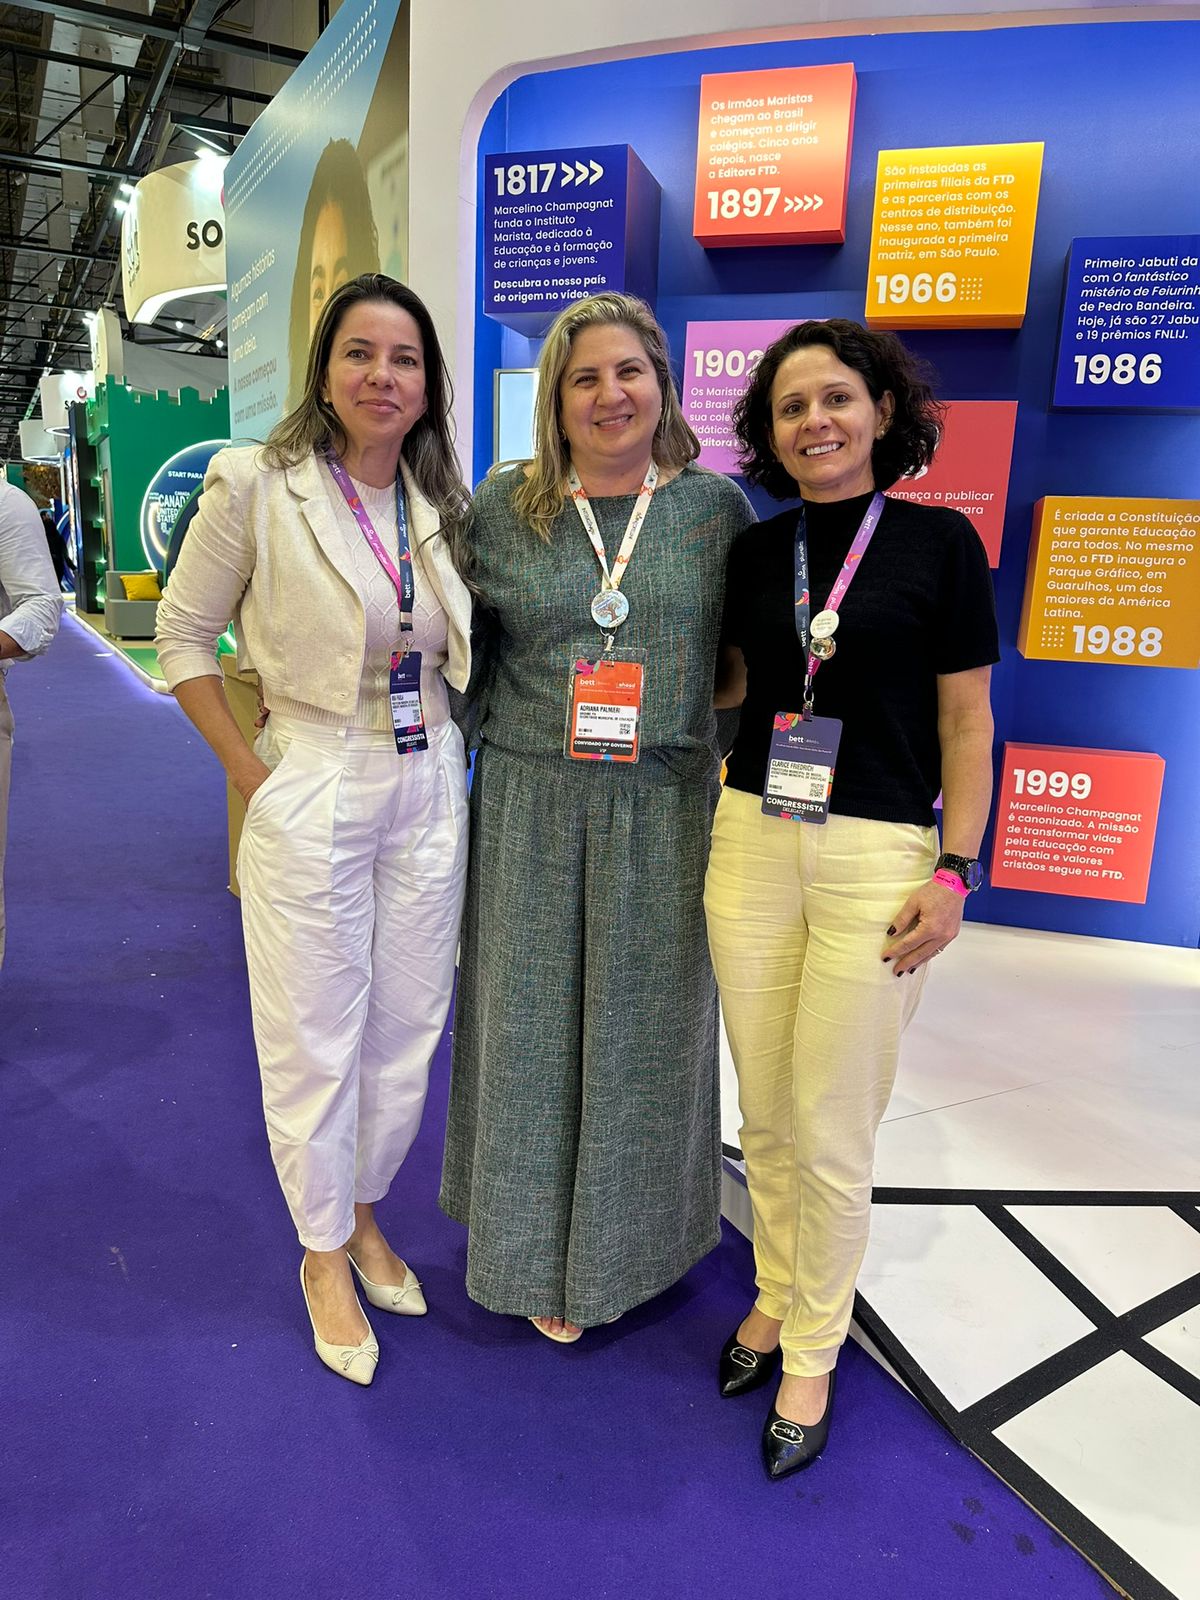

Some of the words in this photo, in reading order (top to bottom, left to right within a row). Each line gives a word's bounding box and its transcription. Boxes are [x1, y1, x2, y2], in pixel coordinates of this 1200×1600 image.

[494, 163, 556, 196] 1817
[709, 171, 716, 179] a
[719, 168, 756, 178] Editora
[758, 165, 780, 176] FTD.
[882, 179, 938, 193] primeiras
[941, 176, 972, 187] filiais
[974, 176, 991, 186] da
[993, 174, 1015, 186] FTD
[708, 187, 781, 219] 1897
[882, 196, 890, 205] e
[891, 196, 906, 204] as
[908, 192, 963, 206] parcerias
[966, 192, 993, 201] com
[995, 190, 1009, 199] os
[494, 203, 543, 215] Marcelino
[545, 199, 614, 213] Champagnat
[881, 209, 924, 219] centros
[926, 207, 941, 217] de
[944, 204, 1016, 217] distribuição.
[494, 218, 523, 229] funda
[525, 219, 532, 227] o
[534, 215, 576, 226] Instituto
[880, 224, 914, 233] Nesse
[916, 223, 941, 231] ano,
[944, 219, 995, 230] também
[997, 217, 1012, 228] foi
[494, 232, 533, 242] Marista,
[535, 228, 584, 240] dedicado
[586, 227, 593, 237] à
[879, 235, 945, 249] inaugurada
[948, 236, 956, 244] a
[959, 232, 1009, 246] primeira
[494, 244, 543, 257] Educação
[545, 245, 552, 253] e
[554, 242, 561, 252] à
[563, 240, 613, 253] formação
[878, 250, 916, 261] matriz,
[918, 251, 937, 259] em
[940, 248, 962, 258] São
[965, 247, 1000, 257] Paulo.
[494, 259, 507, 269] de
[509, 258, 552, 270] crianças
[554, 258, 561, 266] e
[562, 256, 598, 268] jovens.
[1085, 258, 1136, 269] Primeiro
[1138, 256, 1179, 268] Jabuti
[1181, 256, 1198, 266] da
[494, 278, 542, 289] Descubra
[543, 279, 550, 287] o
[552, 278, 582, 286] nosso
[584, 274, 606, 288] país
[1083, 275, 1110, 283] com
[1113, 273, 1123, 283] O
[1125, 271, 1189, 282] fantástico
[876, 272, 957, 304] 1966
[1081, 286, 1131, 297] mistério
[1133, 286, 1150, 296] de
[494, 293, 507, 302] de
[508, 291, 544, 304] origem
[546, 292, 559, 300] no
[560, 289, 592, 300] vídeo.
[1079, 302, 1095, 312] de
[1098, 301, 1133, 311] Pedro
[1136, 300, 1195, 311] Bandeira.
[1078, 316, 1107, 329] Hoje,
[1109, 315, 1122, 329] já
[1125, 316, 1148, 325] são
[1151, 315, 1165, 325] 27
[1076, 332, 1084, 340] e
[1087, 330, 1099, 340] 19
[1101, 329, 1152, 343] prêmios
[1155, 330, 1188, 339] FNLIJ.
[1074, 354, 1162, 385] 1986
[691, 387, 704, 396] Os
[690, 400, 703, 409] do
[158, 496, 188, 508] CANAD
[884, 490, 931, 503] começa
[934, 492, 942, 500] a
[945, 491, 995, 503] publicar
[864, 514, 874, 530] bett
[1055, 509, 1061, 521] É
[1064, 511, 1105, 522] criada
[1108, 514, 1116, 522] a
[1120, 512, 1200, 526] Constituição
[1053, 527, 1077, 537] que
[1080, 527, 1130, 538] garante
[1133, 527, 1197, 540] Educação
[1051, 541, 1081, 551] para
[1084, 540, 1122, 550] todos.
[1125, 541, 1143, 551] No
[1146, 543, 1194, 552] mesmo
[1050, 554, 1076, 565] ano,
[1080, 555, 1088, 563] a
[1091, 554, 1114, 564] FTD
[1117, 554, 1175, 568] inaugura
[1178, 558, 1187, 566] o
[1049, 567, 1092, 579] Parque
[1095, 568, 1143, 580] Gráfico,
[1146, 571, 1167, 579] em
[1047, 581, 1113, 593] Guarulhos,
[1116, 584, 1136, 593] um
[1140, 583, 1163, 594] dos
[1046, 594, 1095, 605] maiores
[1098, 596, 1115, 606] da
[1118, 597, 1171, 608] América
[1044, 608, 1084, 618] Latina.
[1073, 625, 1163, 658] 1988
[788, 734, 804, 743] bett
[771, 759, 790, 769] CLARICE
[1014, 769, 1092, 800] 1999
[766, 796, 824, 813] CONGRESSISTA
[1010, 802, 1064, 814] Marcelino
[1066, 807, 1142, 822] Champagnat
[1008, 813, 1016, 822] é
[1018, 815, 1085, 828] canonizado.
[1088, 821, 1095, 829] A
[1098, 822, 1139, 833] missão
[1007, 825, 1021, 834] de
[1024, 827, 1090, 840] transformar
[1092, 833, 1122, 844] vidas
[1006, 837, 1030, 847] pela
[1032, 839, 1087, 853] Educação
[1089, 846, 1114, 855] com
[1004, 849, 1051, 860] empatia
[1063, 855, 1103, 866] valores
[1003, 860, 1046, 871] cristãos
[1049, 866, 1082, 876] segue
[1102, 870, 1125, 880] FTD.
